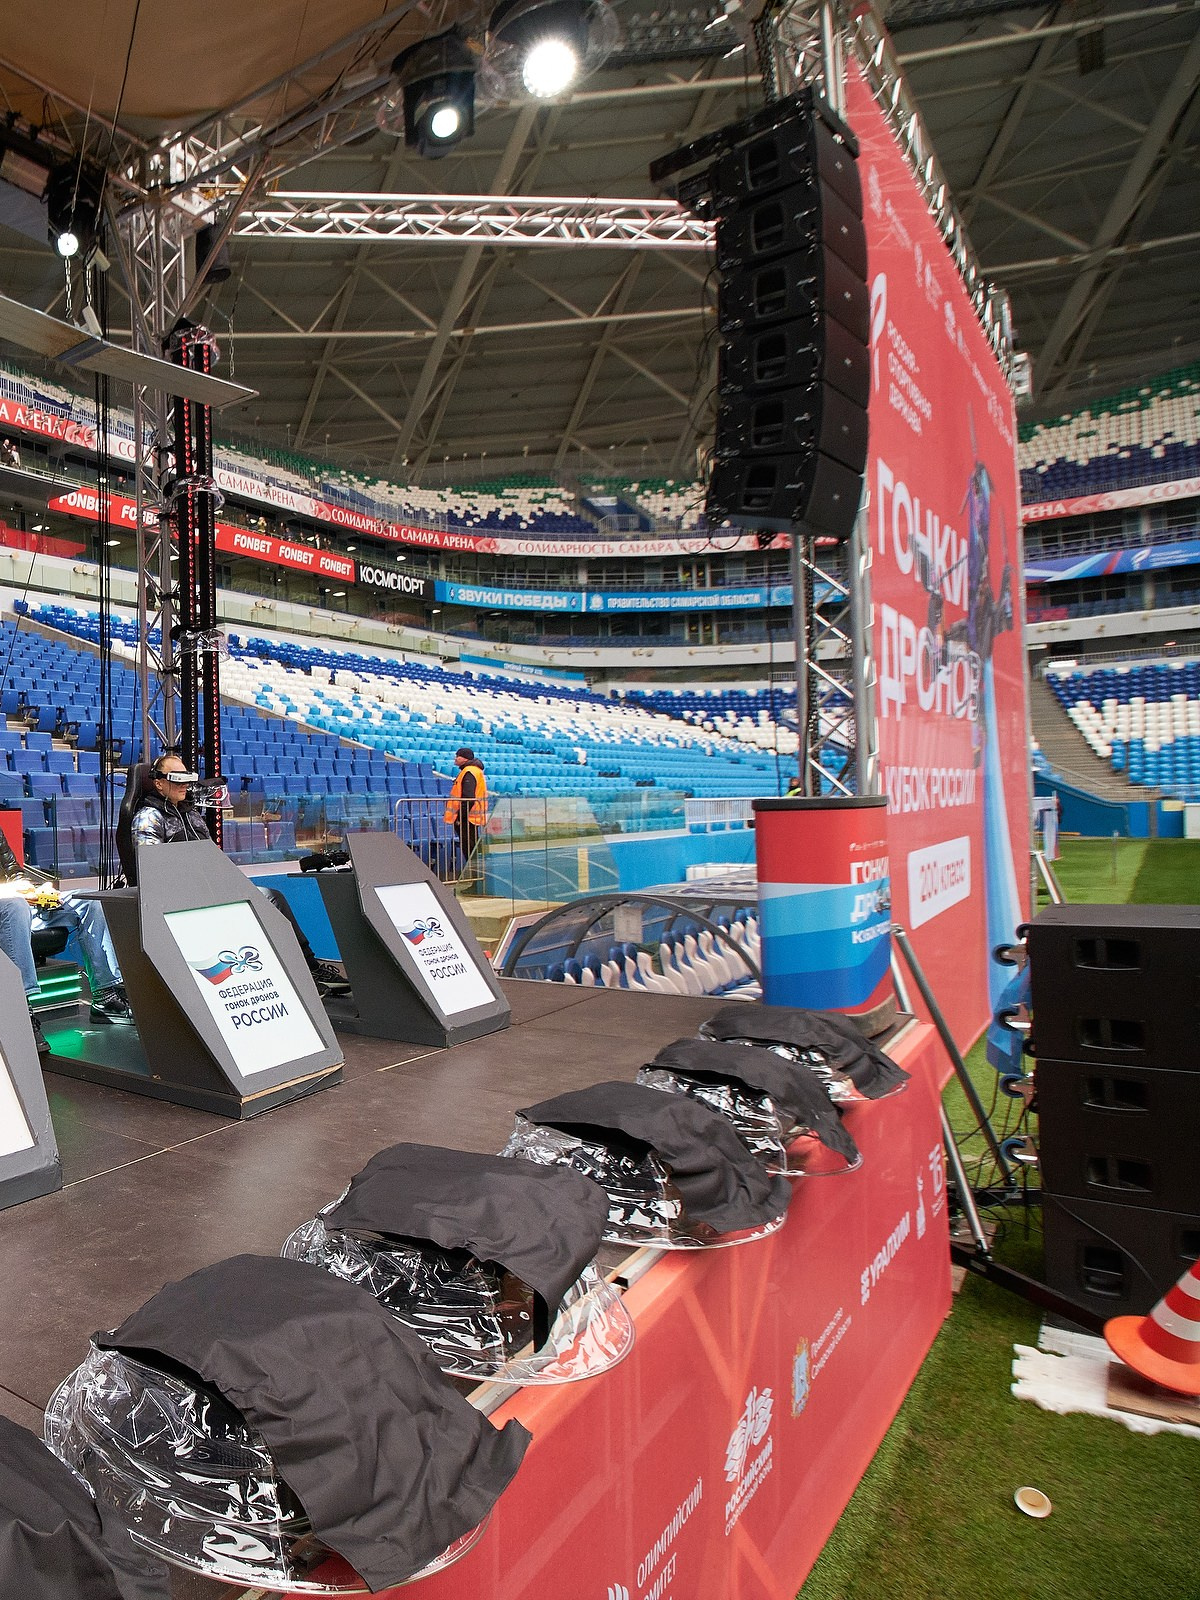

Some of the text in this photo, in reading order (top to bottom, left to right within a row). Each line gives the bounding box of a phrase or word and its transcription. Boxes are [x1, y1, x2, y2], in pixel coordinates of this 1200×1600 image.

[14, 408, 62, 436] АРЕНА
[218, 472, 295, 508] САМАРА АРЕНА
[1022, 502, 1067, 519] РЕНА
[331, 508, 474, 549] СОЛИДАРНОСТЬ САМАРА АРЕНА
[877, 457, 969, 612] ГОНКИ
[234, 534, 272, 554] FONBET
[279, 546, 314, 565] FONBET
[320, 557, 351, 576] FONBET
[518, 541, 614, 555] СОЛИДАРНОСТЬ
[619, 541, 673, 554] САМАРА
[458, 588, 567, 609] ЗВУКИ ПОБЕДЫ
[885, 766, 976, 815] КУБОК РОССИИ
[430, 962, 467, 980] РОССИИ
[218, 978, 274, 999] ФЕДЕРАЦИЯ
[231, 1002, 289, 1030] РОССИИ
[725, 1435, 773, 1521] РОССИЙСКИЙ
[637, 1476, 703, 1588] ОЛИМПИЙСКИЙ
